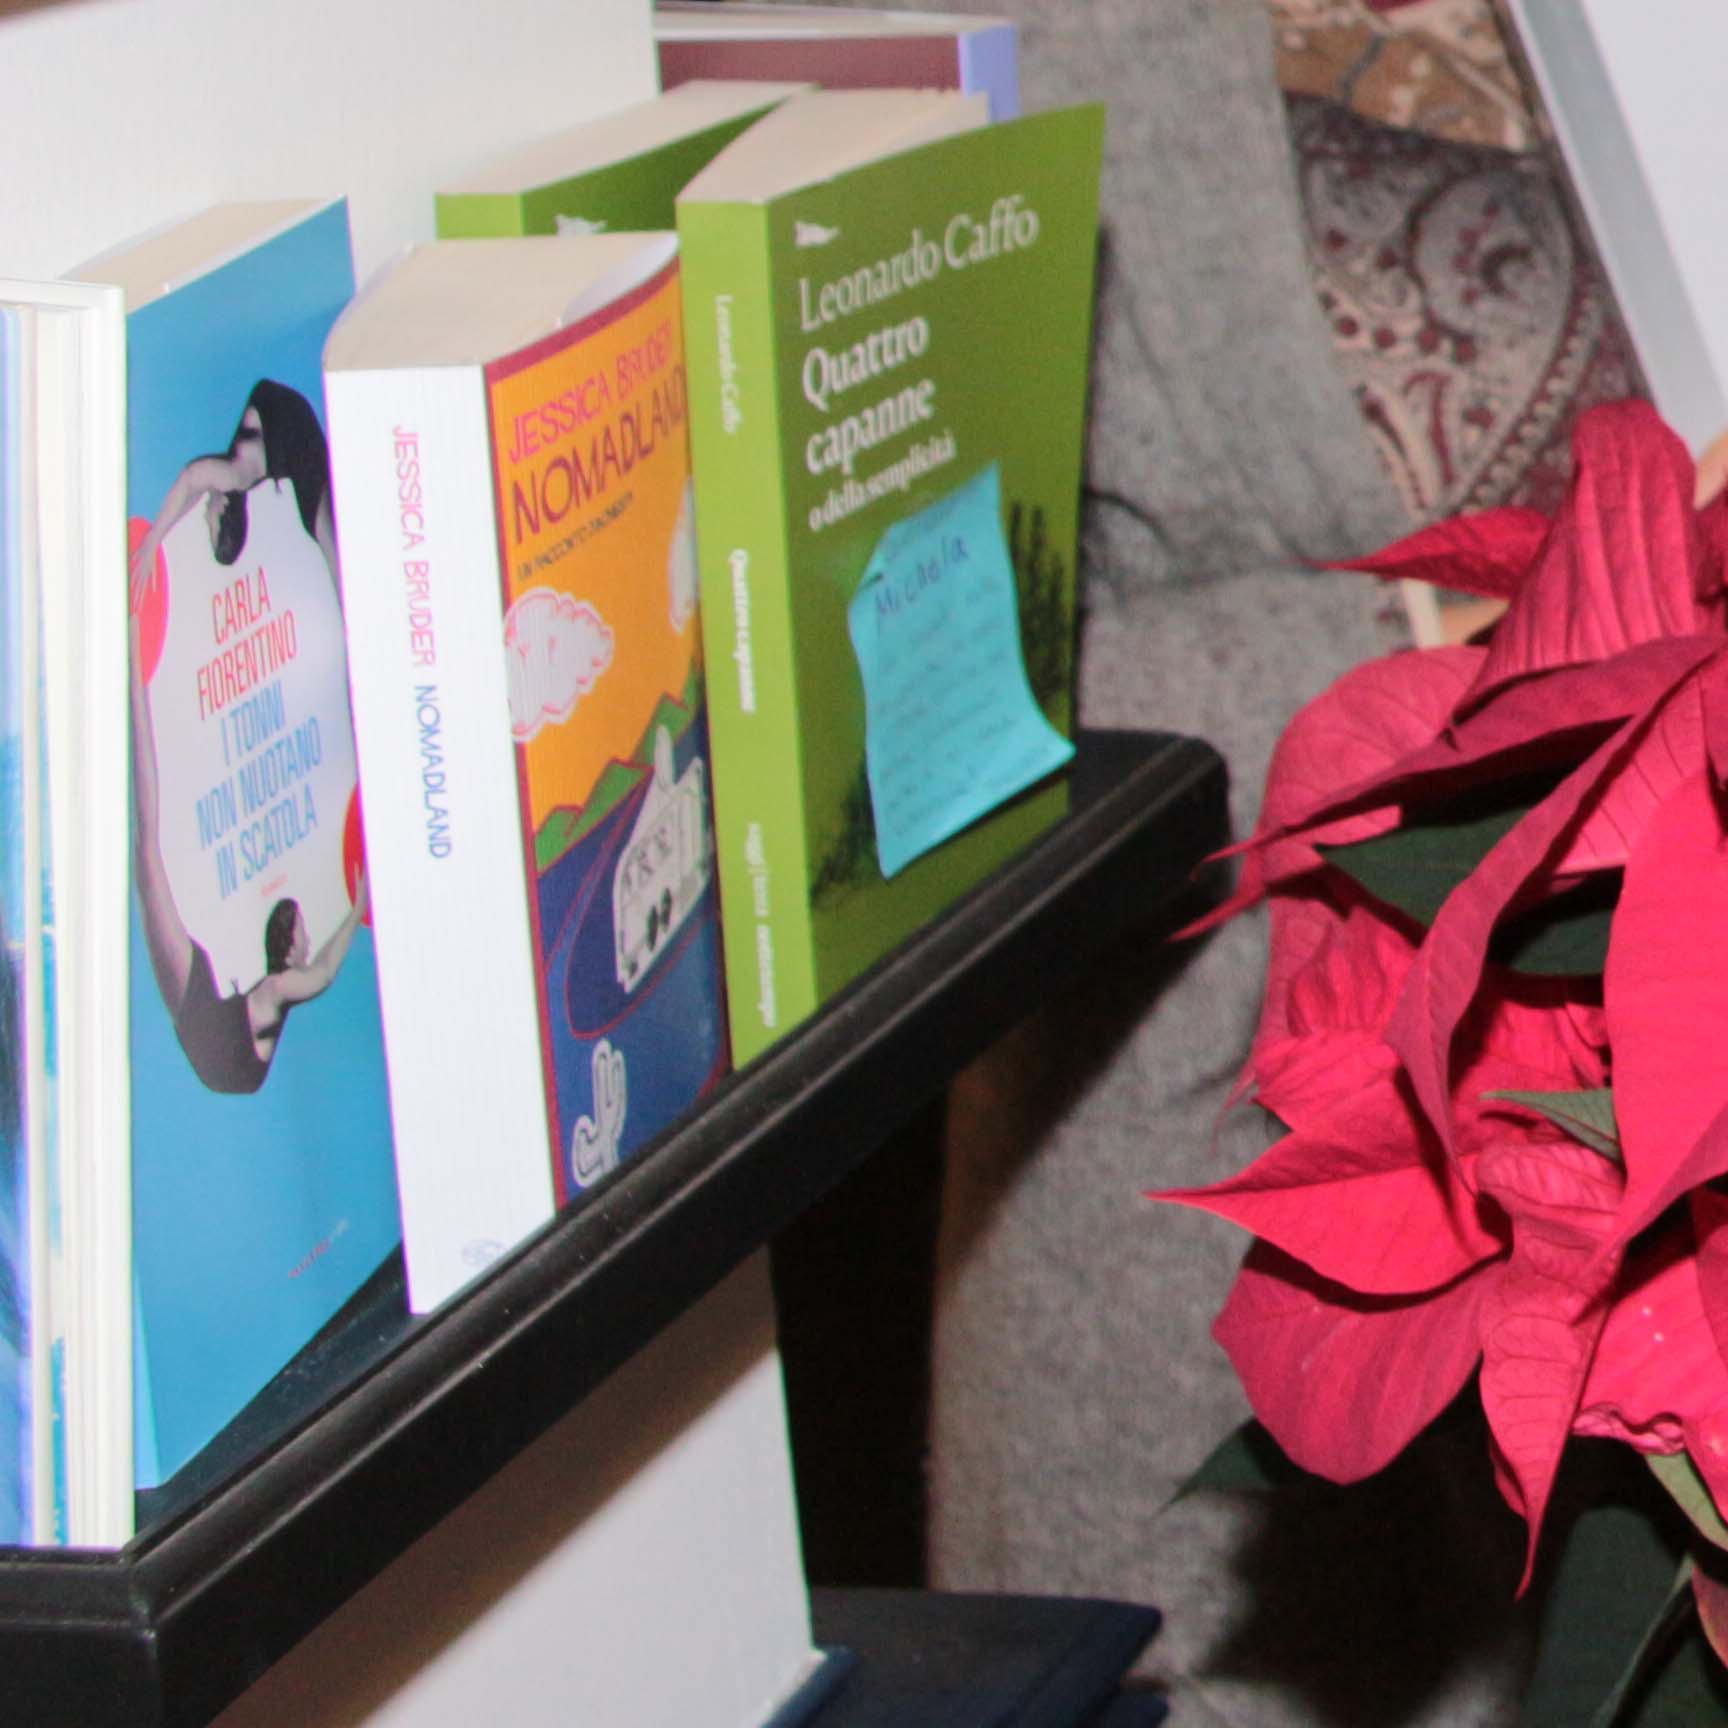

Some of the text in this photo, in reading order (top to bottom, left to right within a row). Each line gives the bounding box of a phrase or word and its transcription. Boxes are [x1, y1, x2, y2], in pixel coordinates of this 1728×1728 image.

[798, 195, 1040, 333] Leonardo Caffo
[802, 316, 930, 412] Quattro
[509, 369, 612, 465] JESSICA
[511, 363, 690, 546] NOMADLAND
[805, 378, 936, 475] capanne
[808, 505, 823, 534] o
[211, 565, 272, 647] CARLA
[392, 424, 452, 859] JESSICA BRUDER NOMADLAND
[196, 609, 298, 722] FIORENTINO
[219, 679, 287, 767] I TONNI
[195, 715, 322, 852] NON NUOTANO
[216, 782, 319, 901] IN SCATOLA
